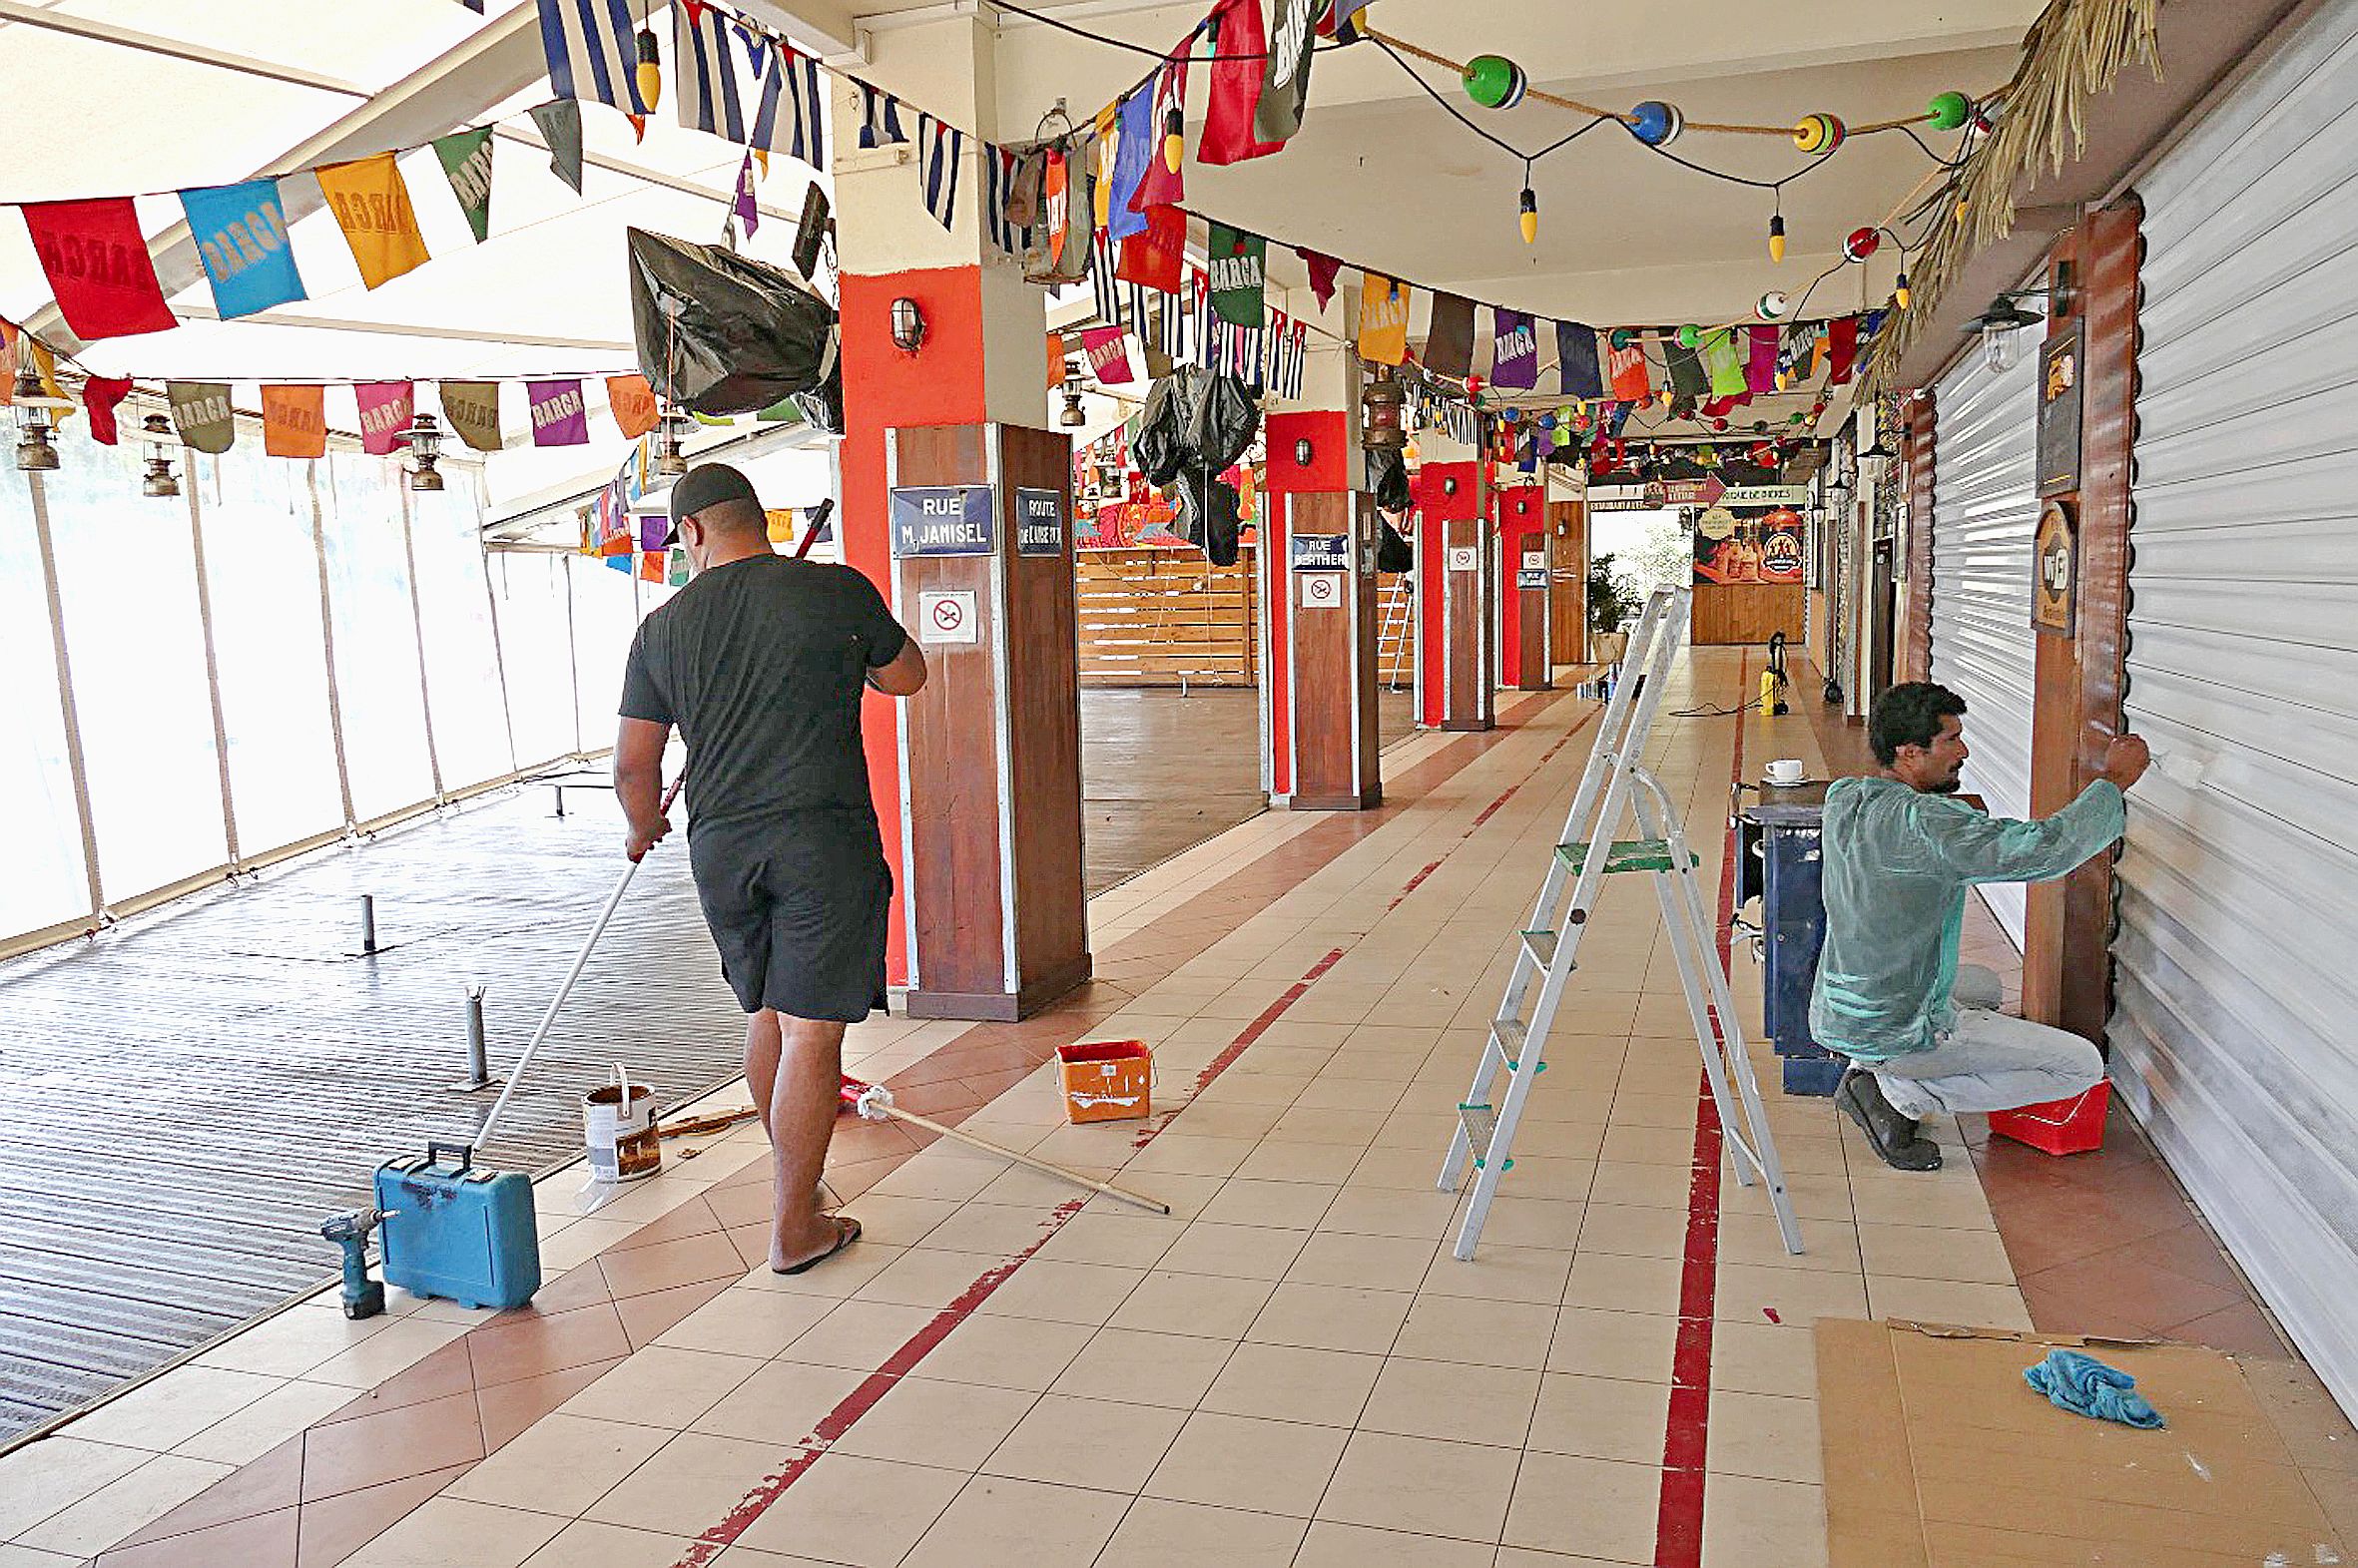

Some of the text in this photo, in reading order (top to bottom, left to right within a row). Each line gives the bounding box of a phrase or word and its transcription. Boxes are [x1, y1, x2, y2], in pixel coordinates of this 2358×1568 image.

[532, 389, 582, 428] BARCA
[923, 499, 960, 516] RUE
[1029, 499, 1056, 517] ROUTE
[1309, 540, 1332, 551] RUE
